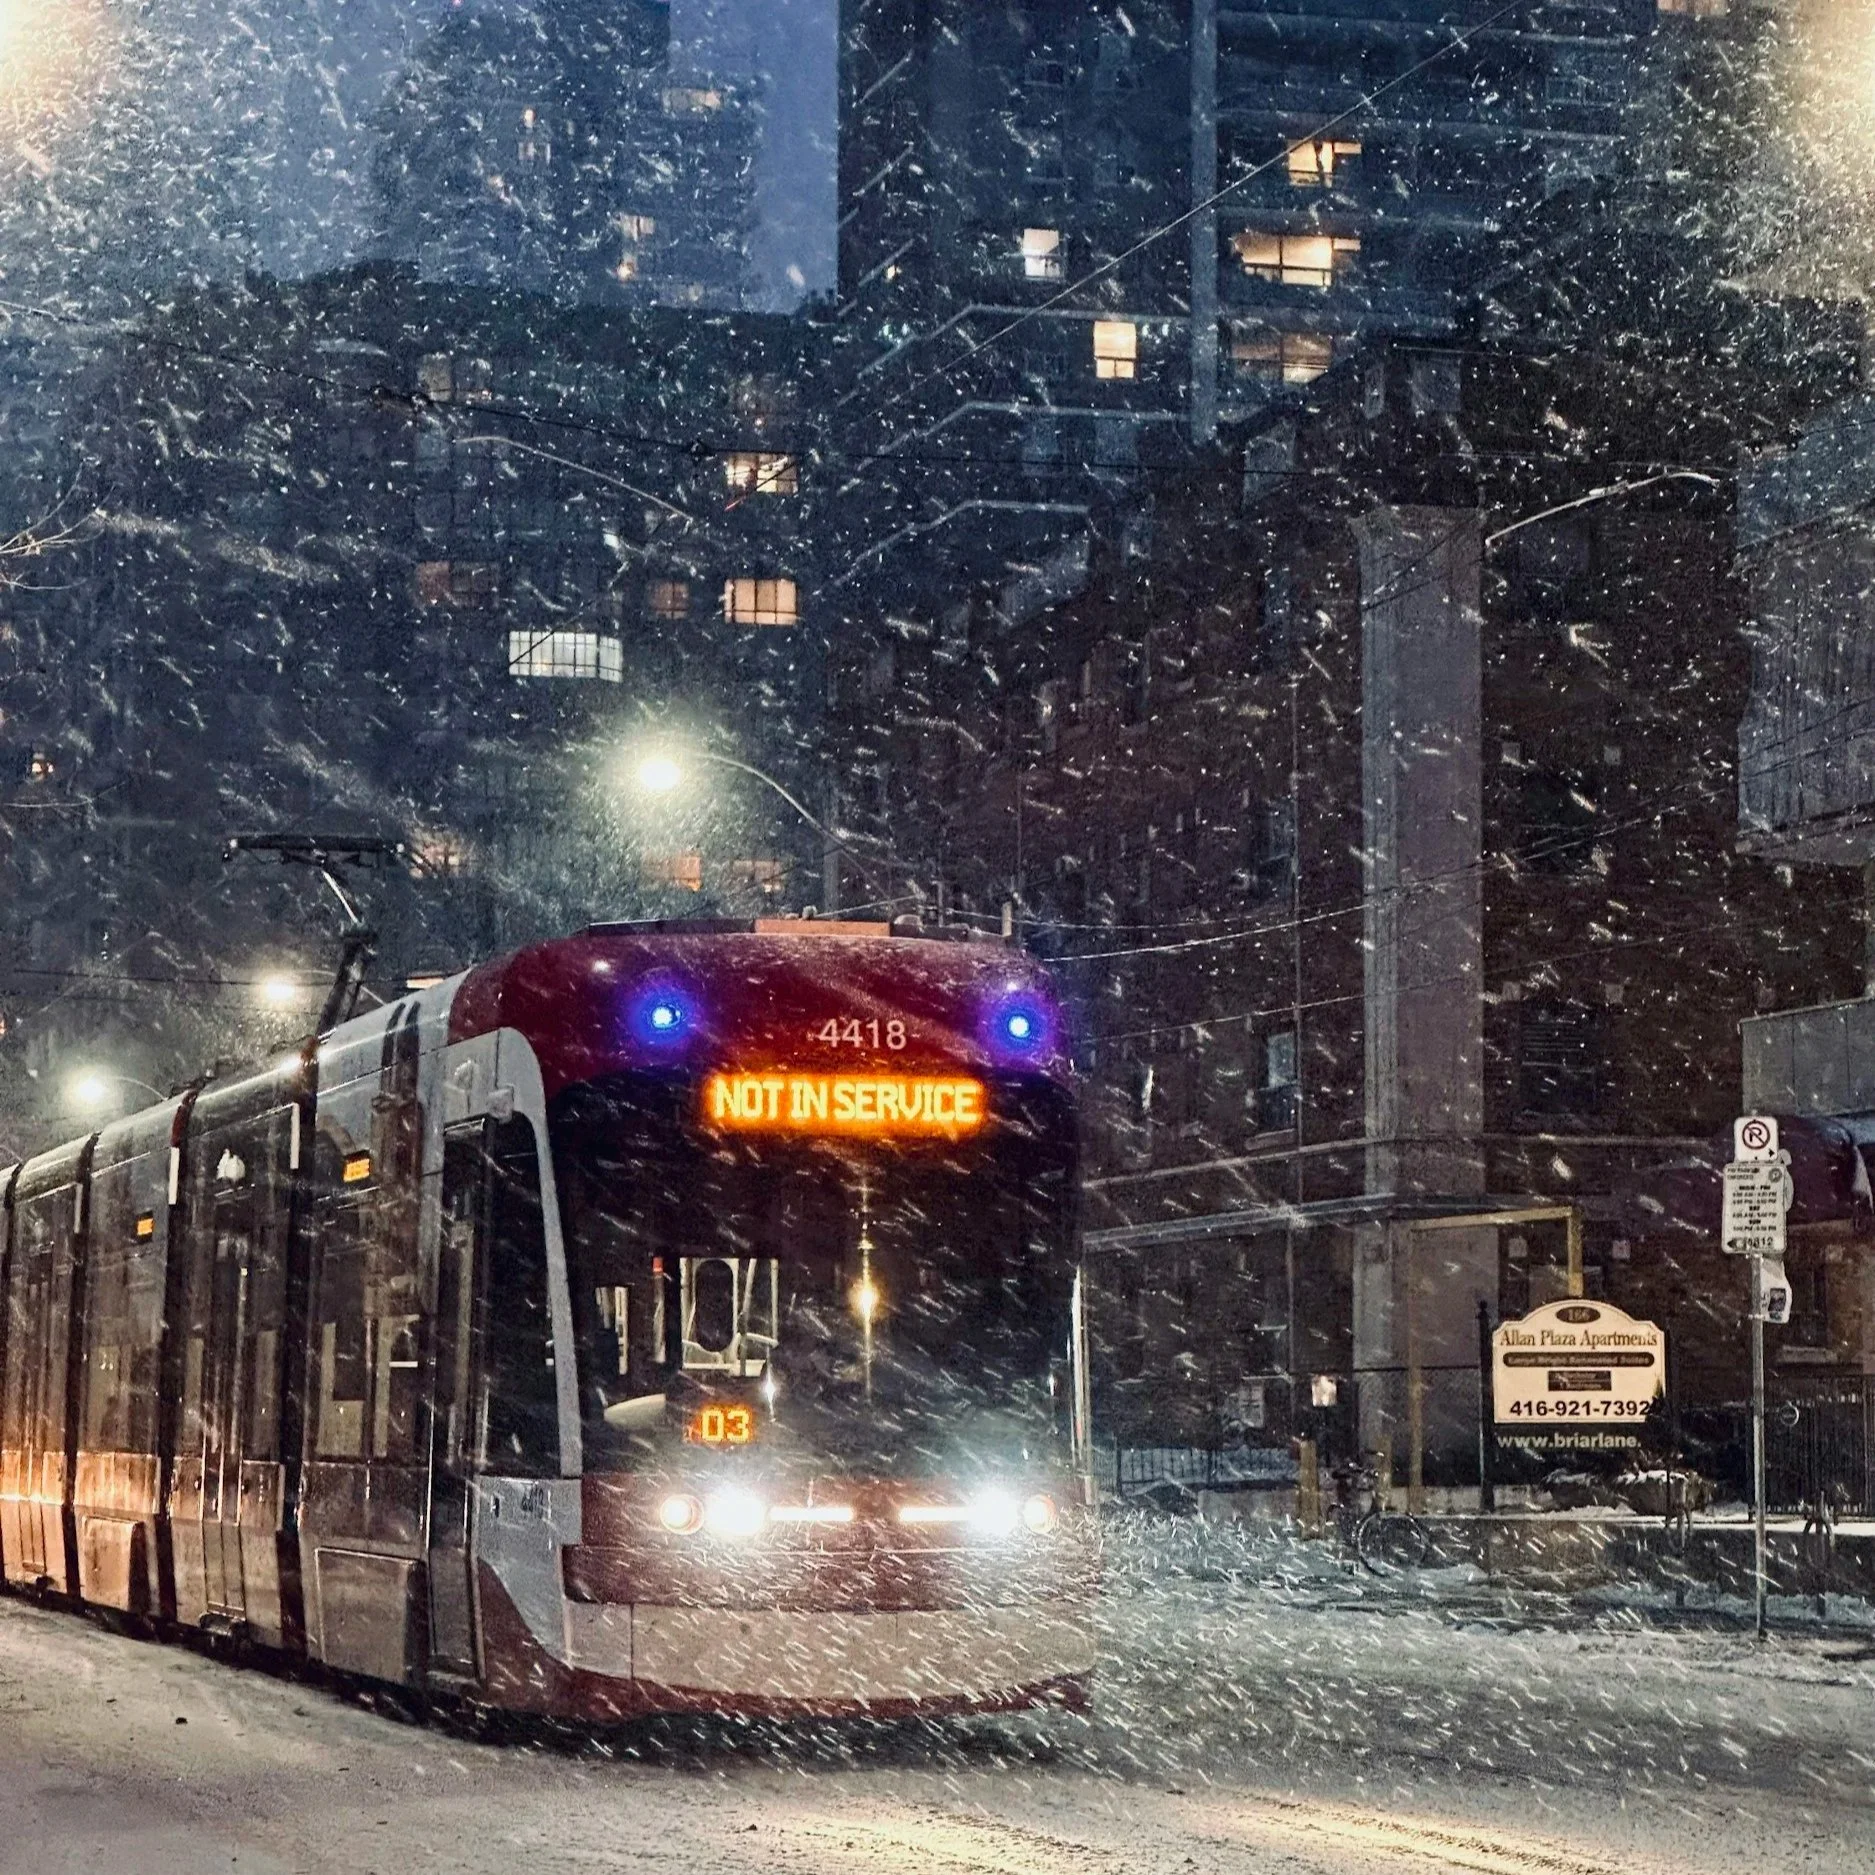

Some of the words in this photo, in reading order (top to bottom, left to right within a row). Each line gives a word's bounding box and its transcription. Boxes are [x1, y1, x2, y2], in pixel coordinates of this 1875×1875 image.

[816, 1019, 907, 1050] 4418
[714, 1080, 785, 1120] NOT
[790, 1080, 828, 1121] IN
[832, 1080, 980, 1123] SERVICE
[1500, 1330, 1536, 1346] Allan
[1540, 1330, 1577, 1346] Plaza
[1579, 1329, 1658, 1350] Apartments
[1510, 1400, 1651, 1416] 416-921-7392
[701, 1409, 750, 1444] 03
